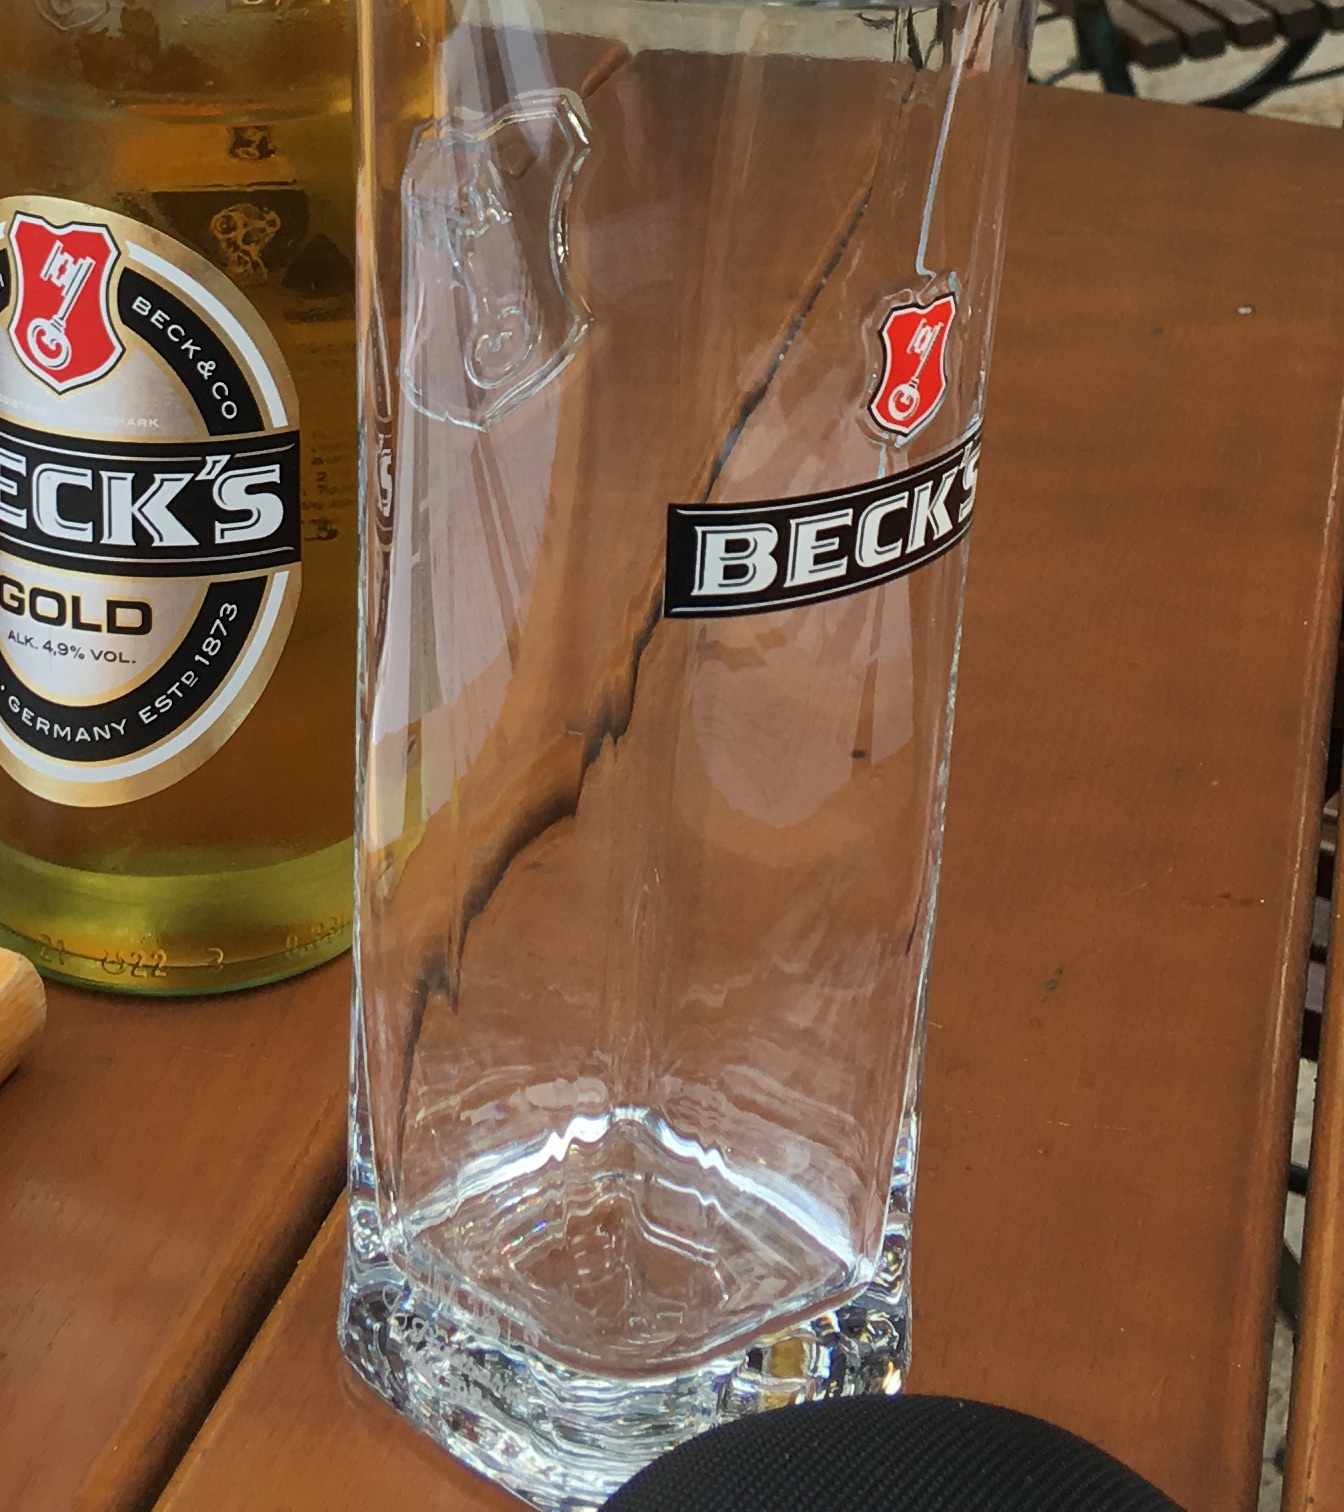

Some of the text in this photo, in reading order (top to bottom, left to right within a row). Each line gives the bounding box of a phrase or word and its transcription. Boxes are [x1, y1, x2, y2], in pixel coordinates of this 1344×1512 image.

[7, 694, 128, 743] GERMANY
[194, 601, 239, 667] 1873
[8, 629, 137, 665] ALK. 4,9% VOL.
